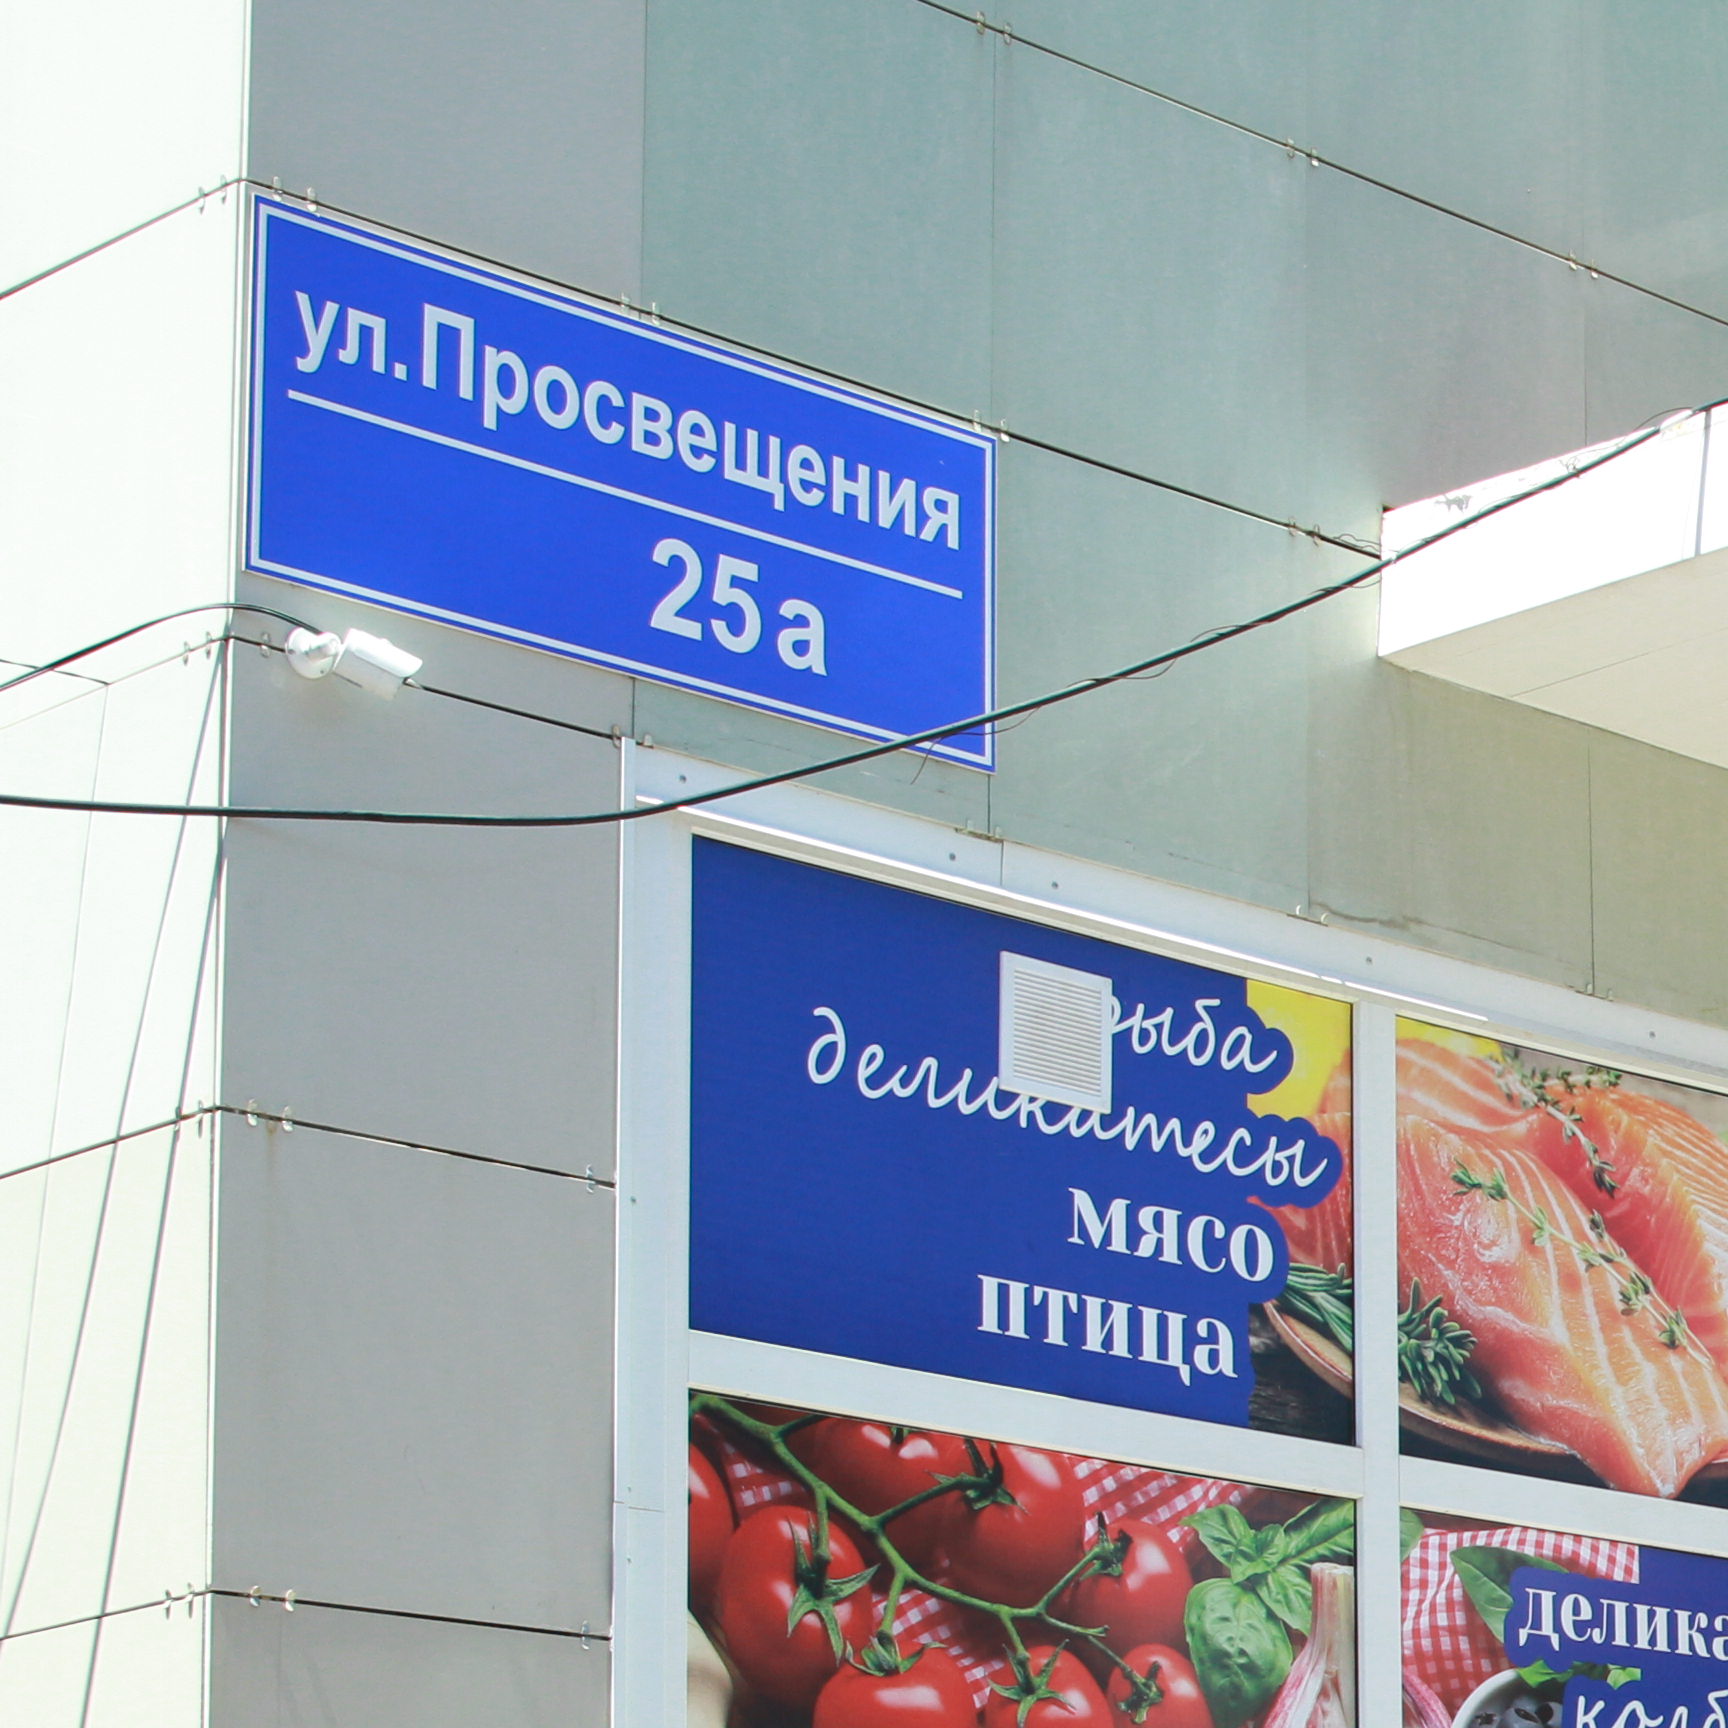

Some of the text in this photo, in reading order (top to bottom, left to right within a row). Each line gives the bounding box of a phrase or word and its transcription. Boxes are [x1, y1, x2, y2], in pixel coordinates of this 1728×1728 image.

[1107, 993, 1278, 1074] ыба
[806, 1006, 1328, 1189] деликатесы
[1068, 1187, 1275, 1283] мясо
[977, 1273, 1239, 1387] птица
